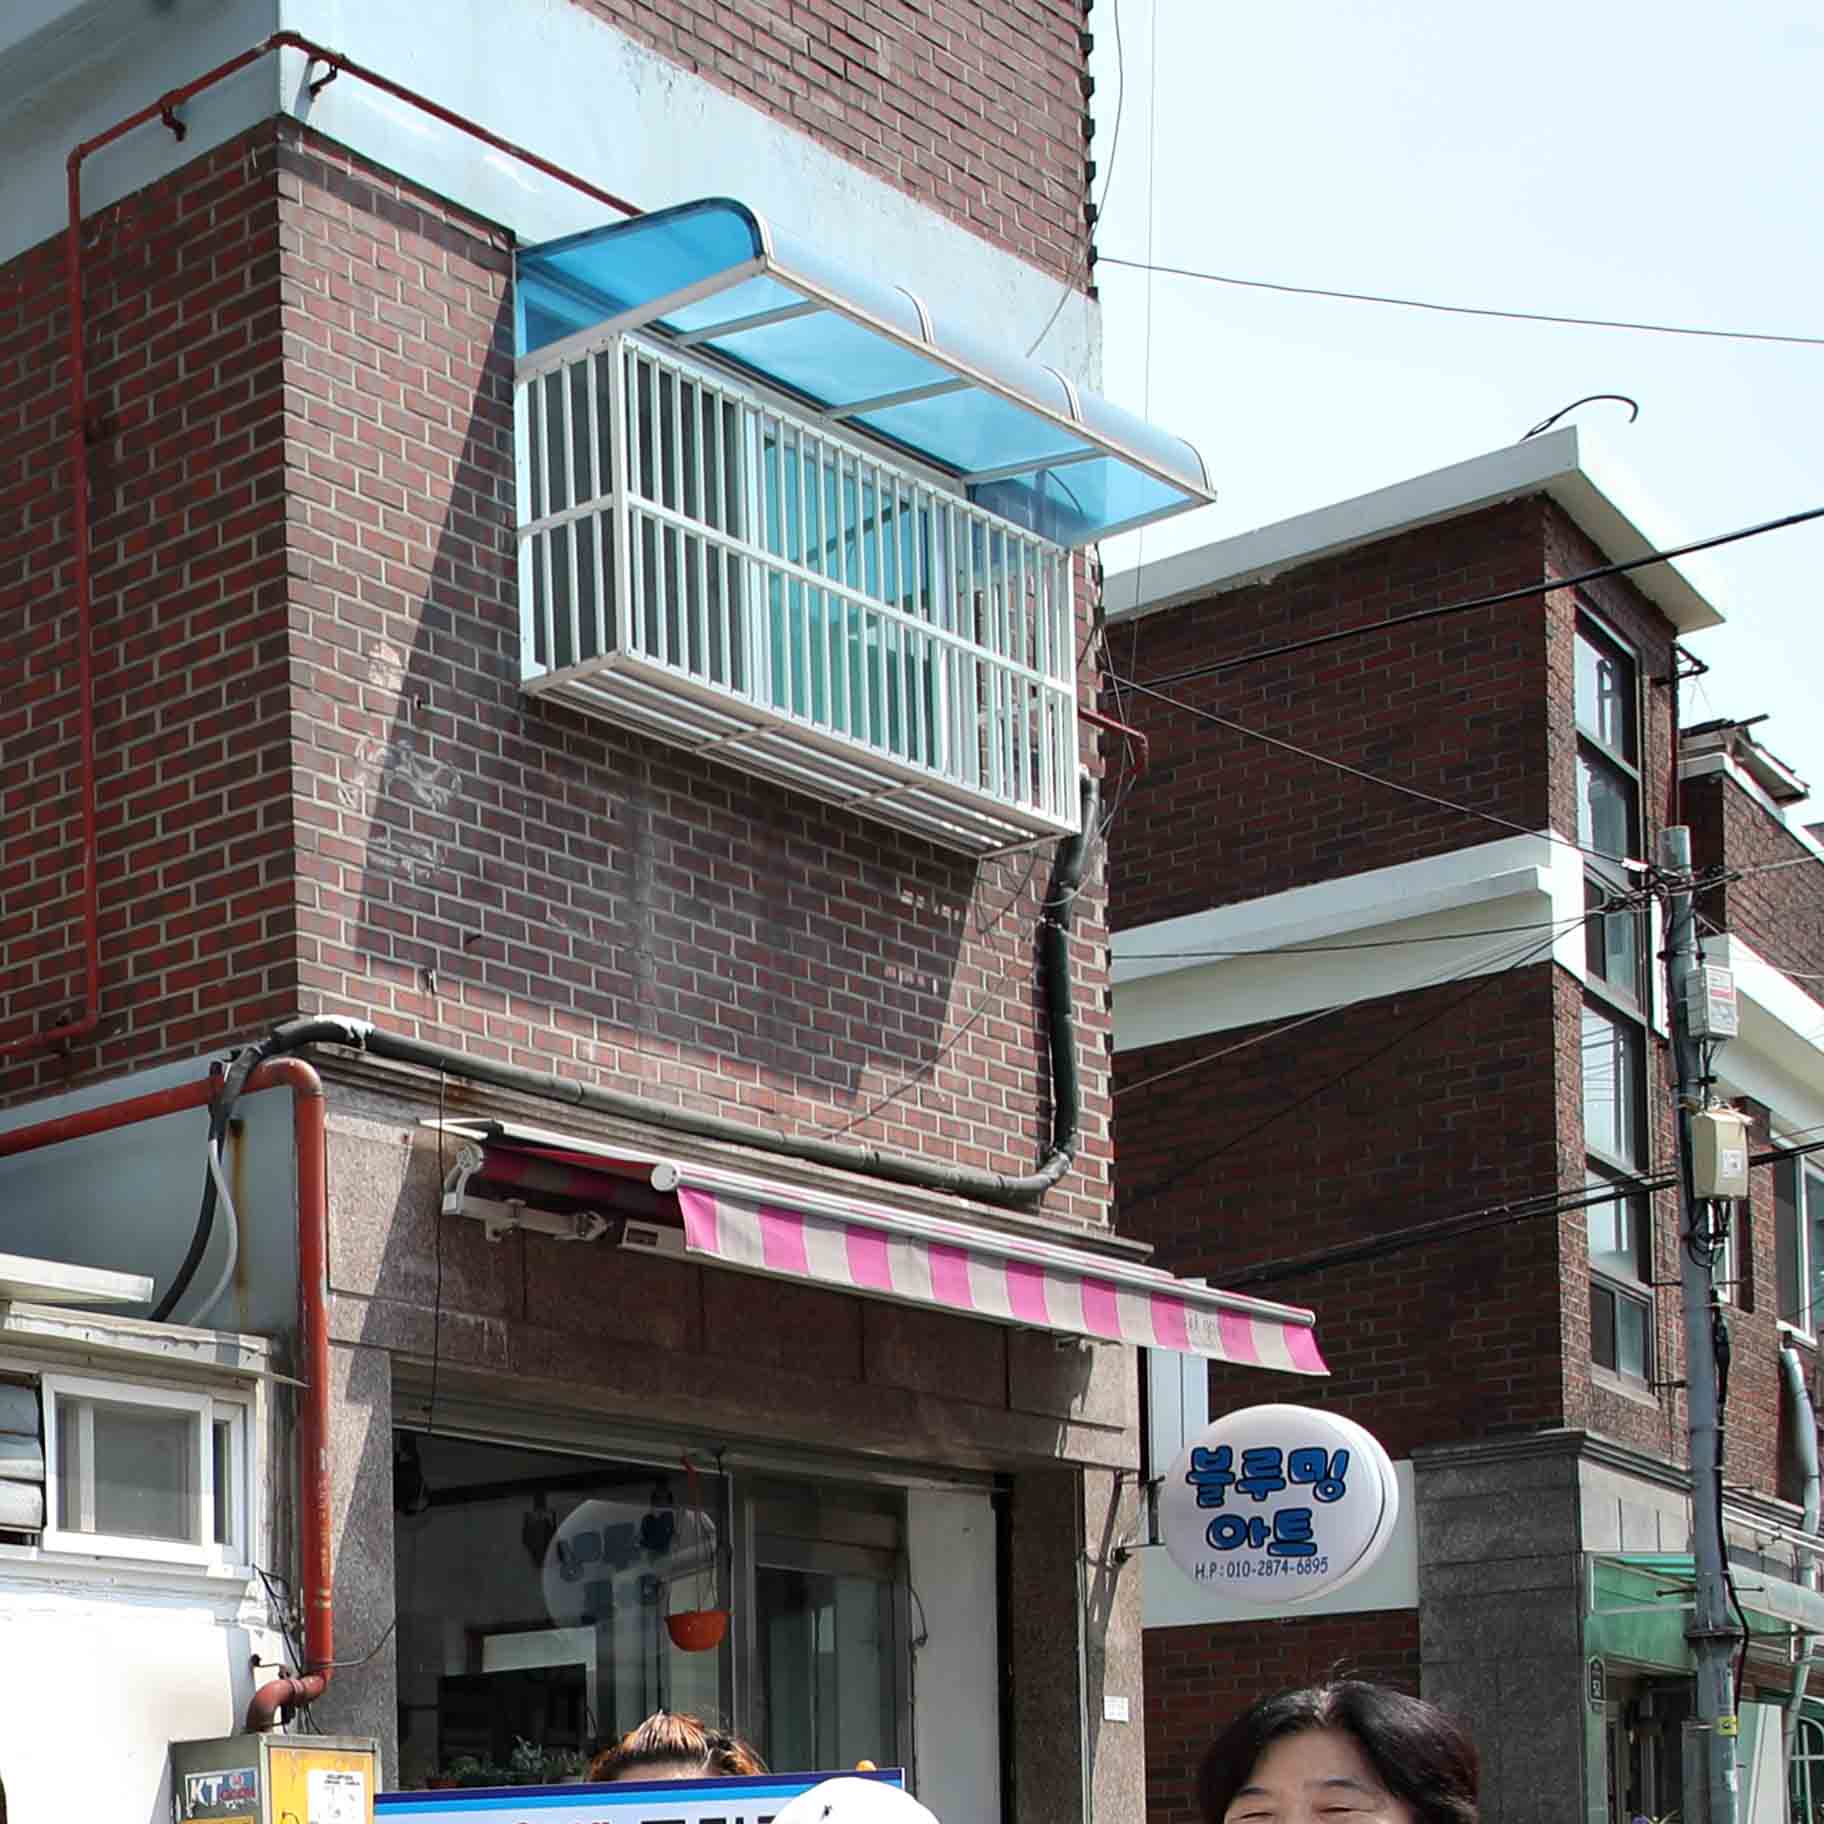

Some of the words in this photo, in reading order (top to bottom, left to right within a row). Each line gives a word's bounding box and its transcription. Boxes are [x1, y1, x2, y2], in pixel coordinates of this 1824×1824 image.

[1185, 1445, 1350, 1509] 블루밍
[1206, 1507, 1318, 1558] 아트
[190, 1776, 224, 1808] KT
